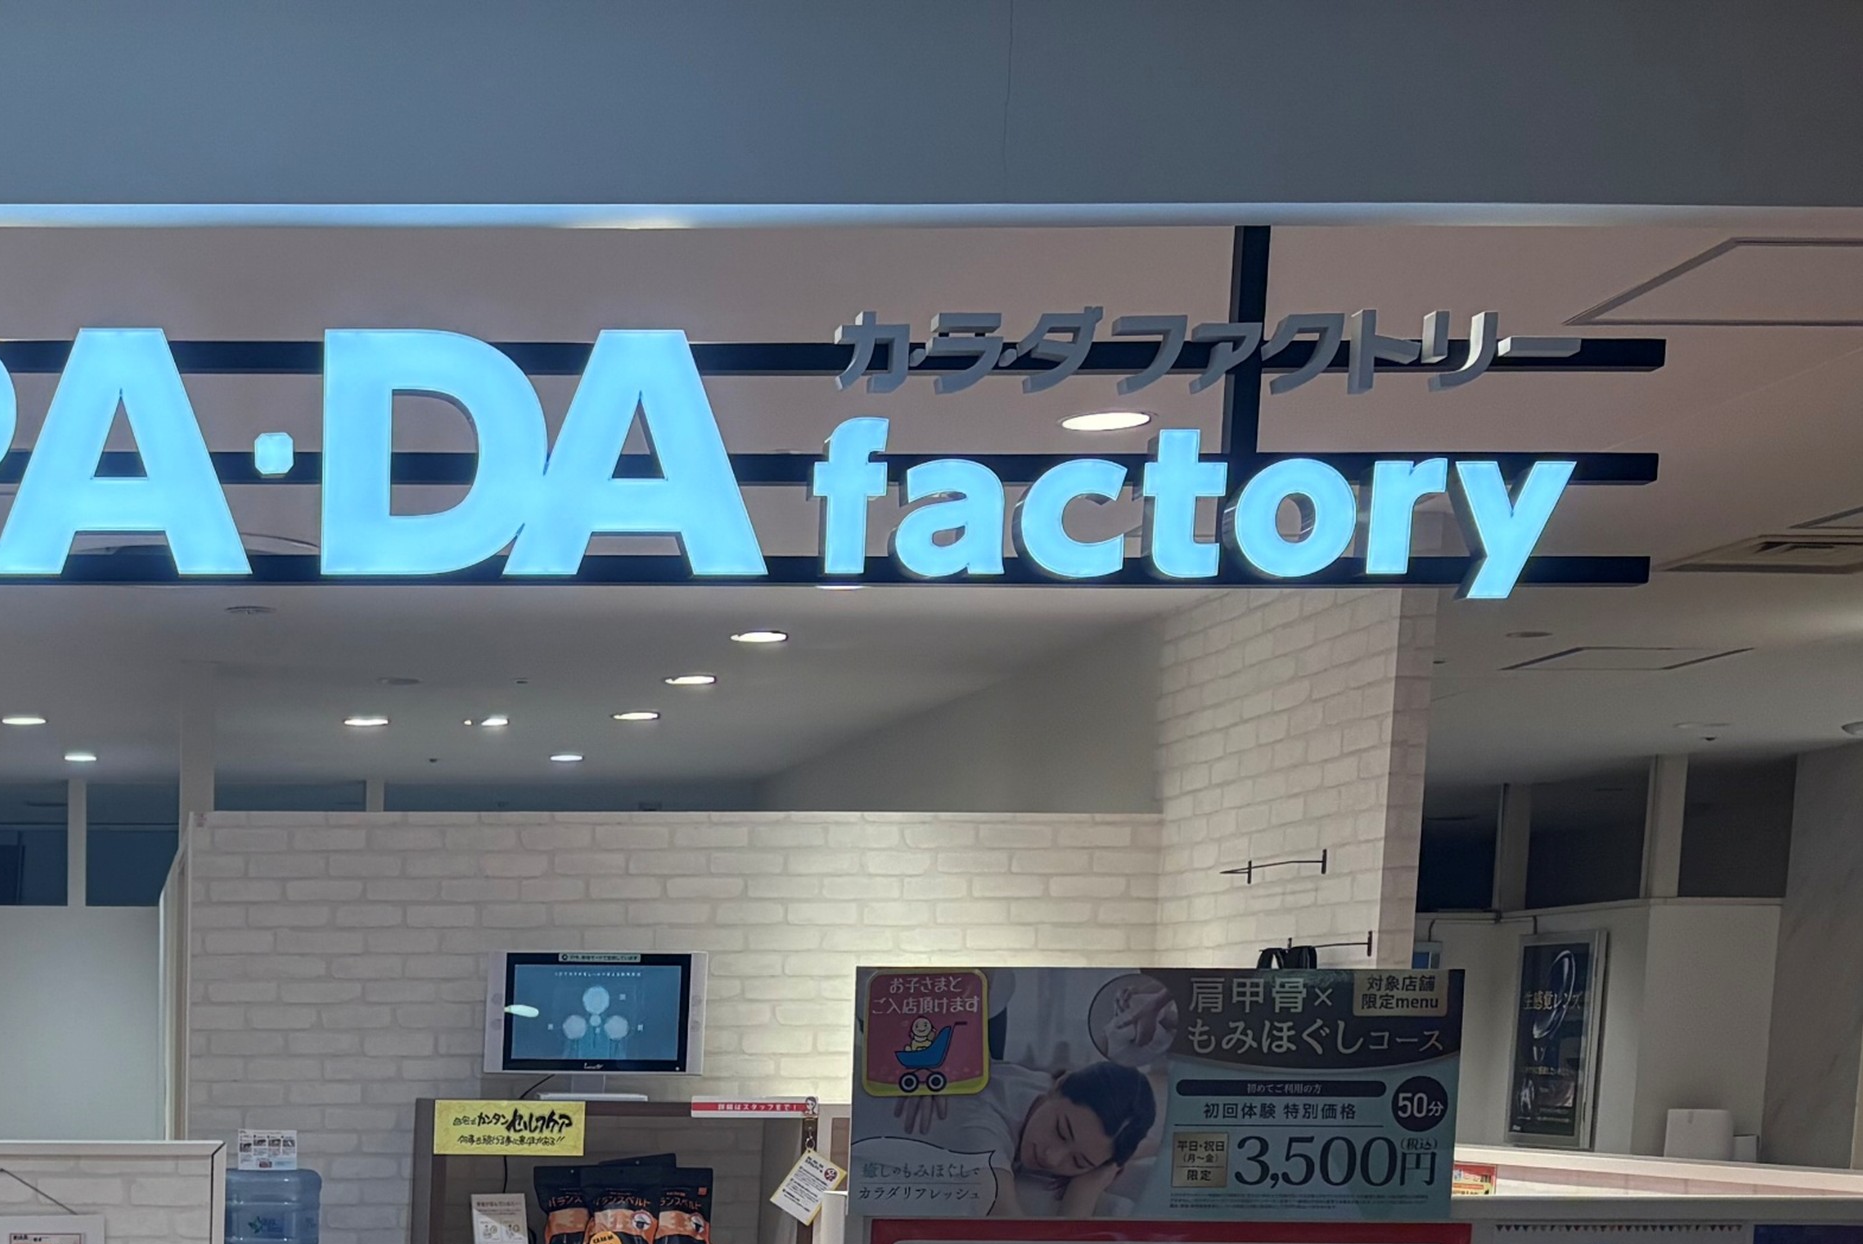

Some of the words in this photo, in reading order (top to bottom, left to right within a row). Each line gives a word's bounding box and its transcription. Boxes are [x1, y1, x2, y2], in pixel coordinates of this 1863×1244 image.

[814, 416, 1577, 598] factory
[890, 977, 962, 994] お子さまと
[1367, 975, 1435, 991] 対象店舗
[873, 996, 979, 1014] ご入店頂けます
[1361, 994, 1439, 1010] 限定menu
[1188, 1019, 1443, 1055] もみほぐしコース
[1247, 1084, 1322, 1094] 初めてご利用の方
[1203, 1103, 1277, 1119] 初回体験
[1284, 1103, 1356, 1119] 特別価格
[1398, 1093, 1444, 1118] 50分
[1177, 1141, 1225, 1152] 平日・祝日
[1187, 1170, 1211, 1181] 限定
[859, 1186, 979, 1200] カラダリフレッシュ
